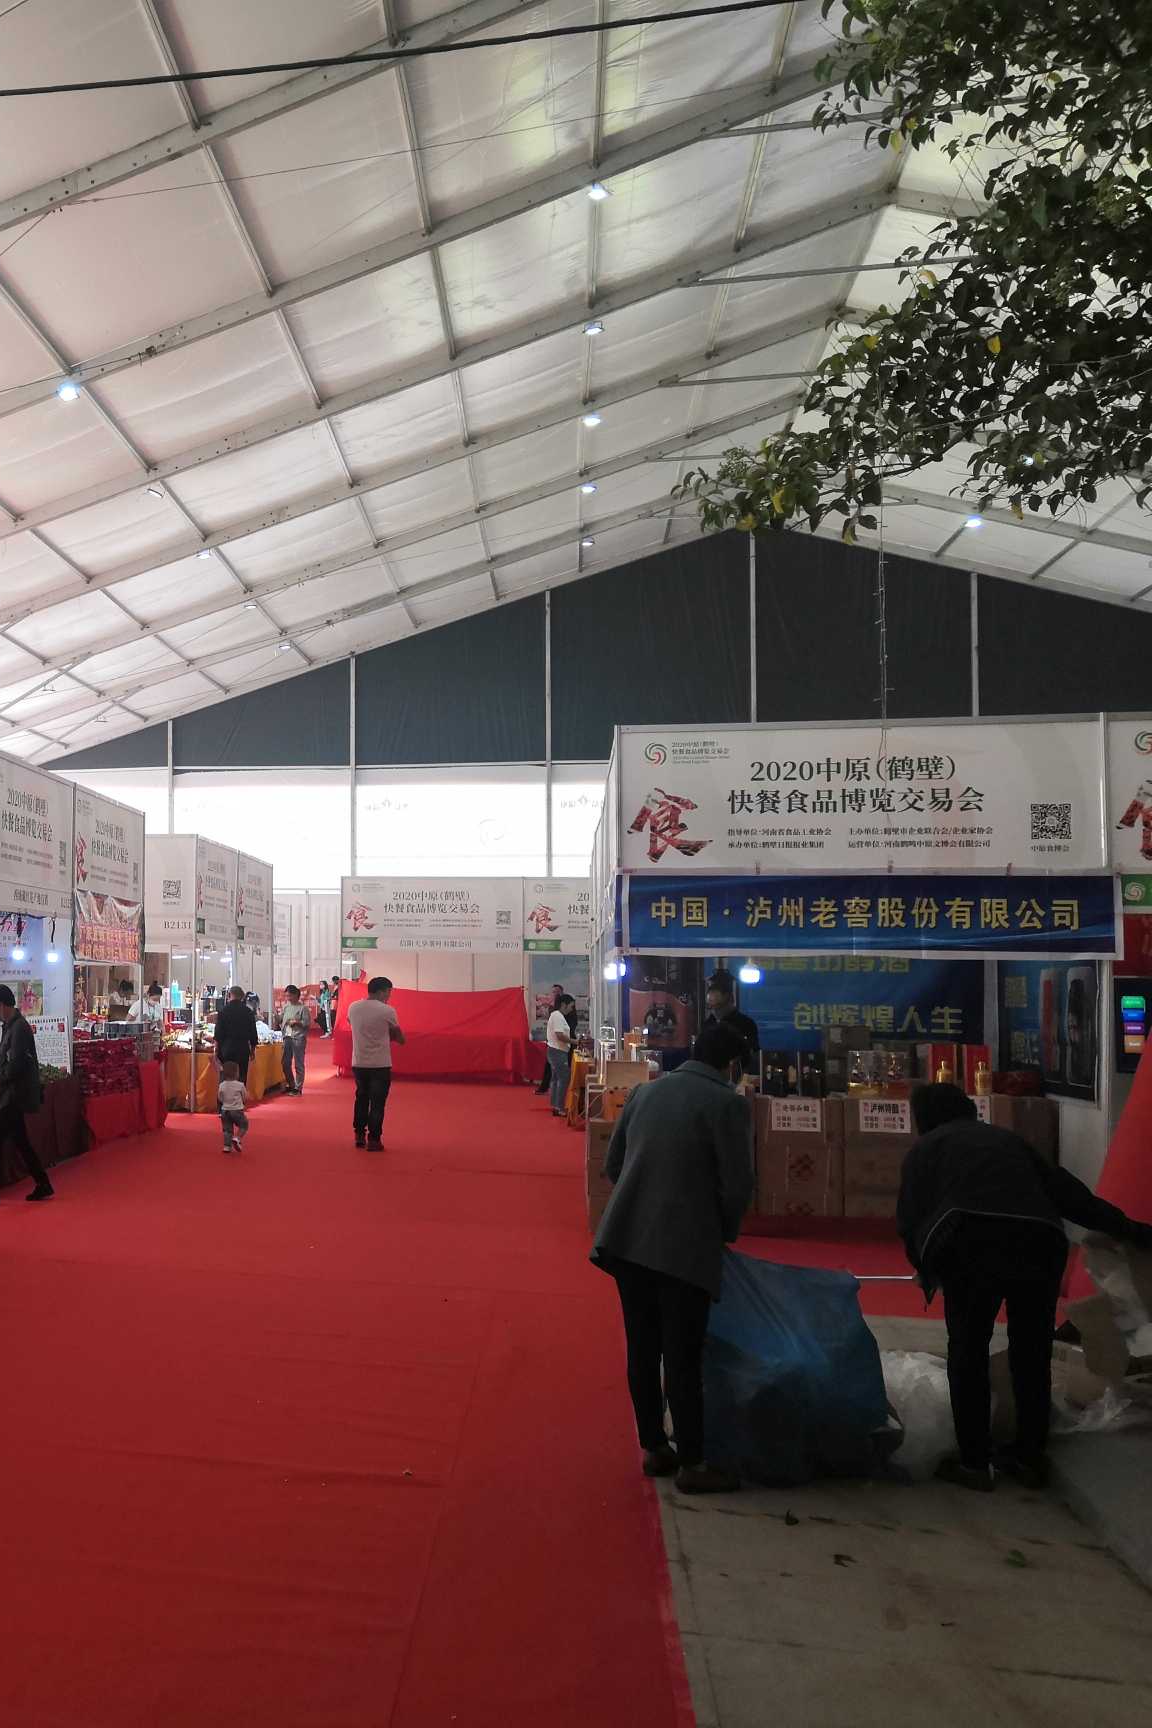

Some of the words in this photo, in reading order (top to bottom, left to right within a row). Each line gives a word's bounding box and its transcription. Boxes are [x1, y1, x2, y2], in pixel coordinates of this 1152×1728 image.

[749, 754, 957, 783] 2020中原(鹤壁)
[728, 786, 985, 816] 快餐食品博览交易会
[384, 903, 480, 914] 快餐食品博览交易会
[651, 895, 1081, 931] 中国·泸州老窖股份有限公司
